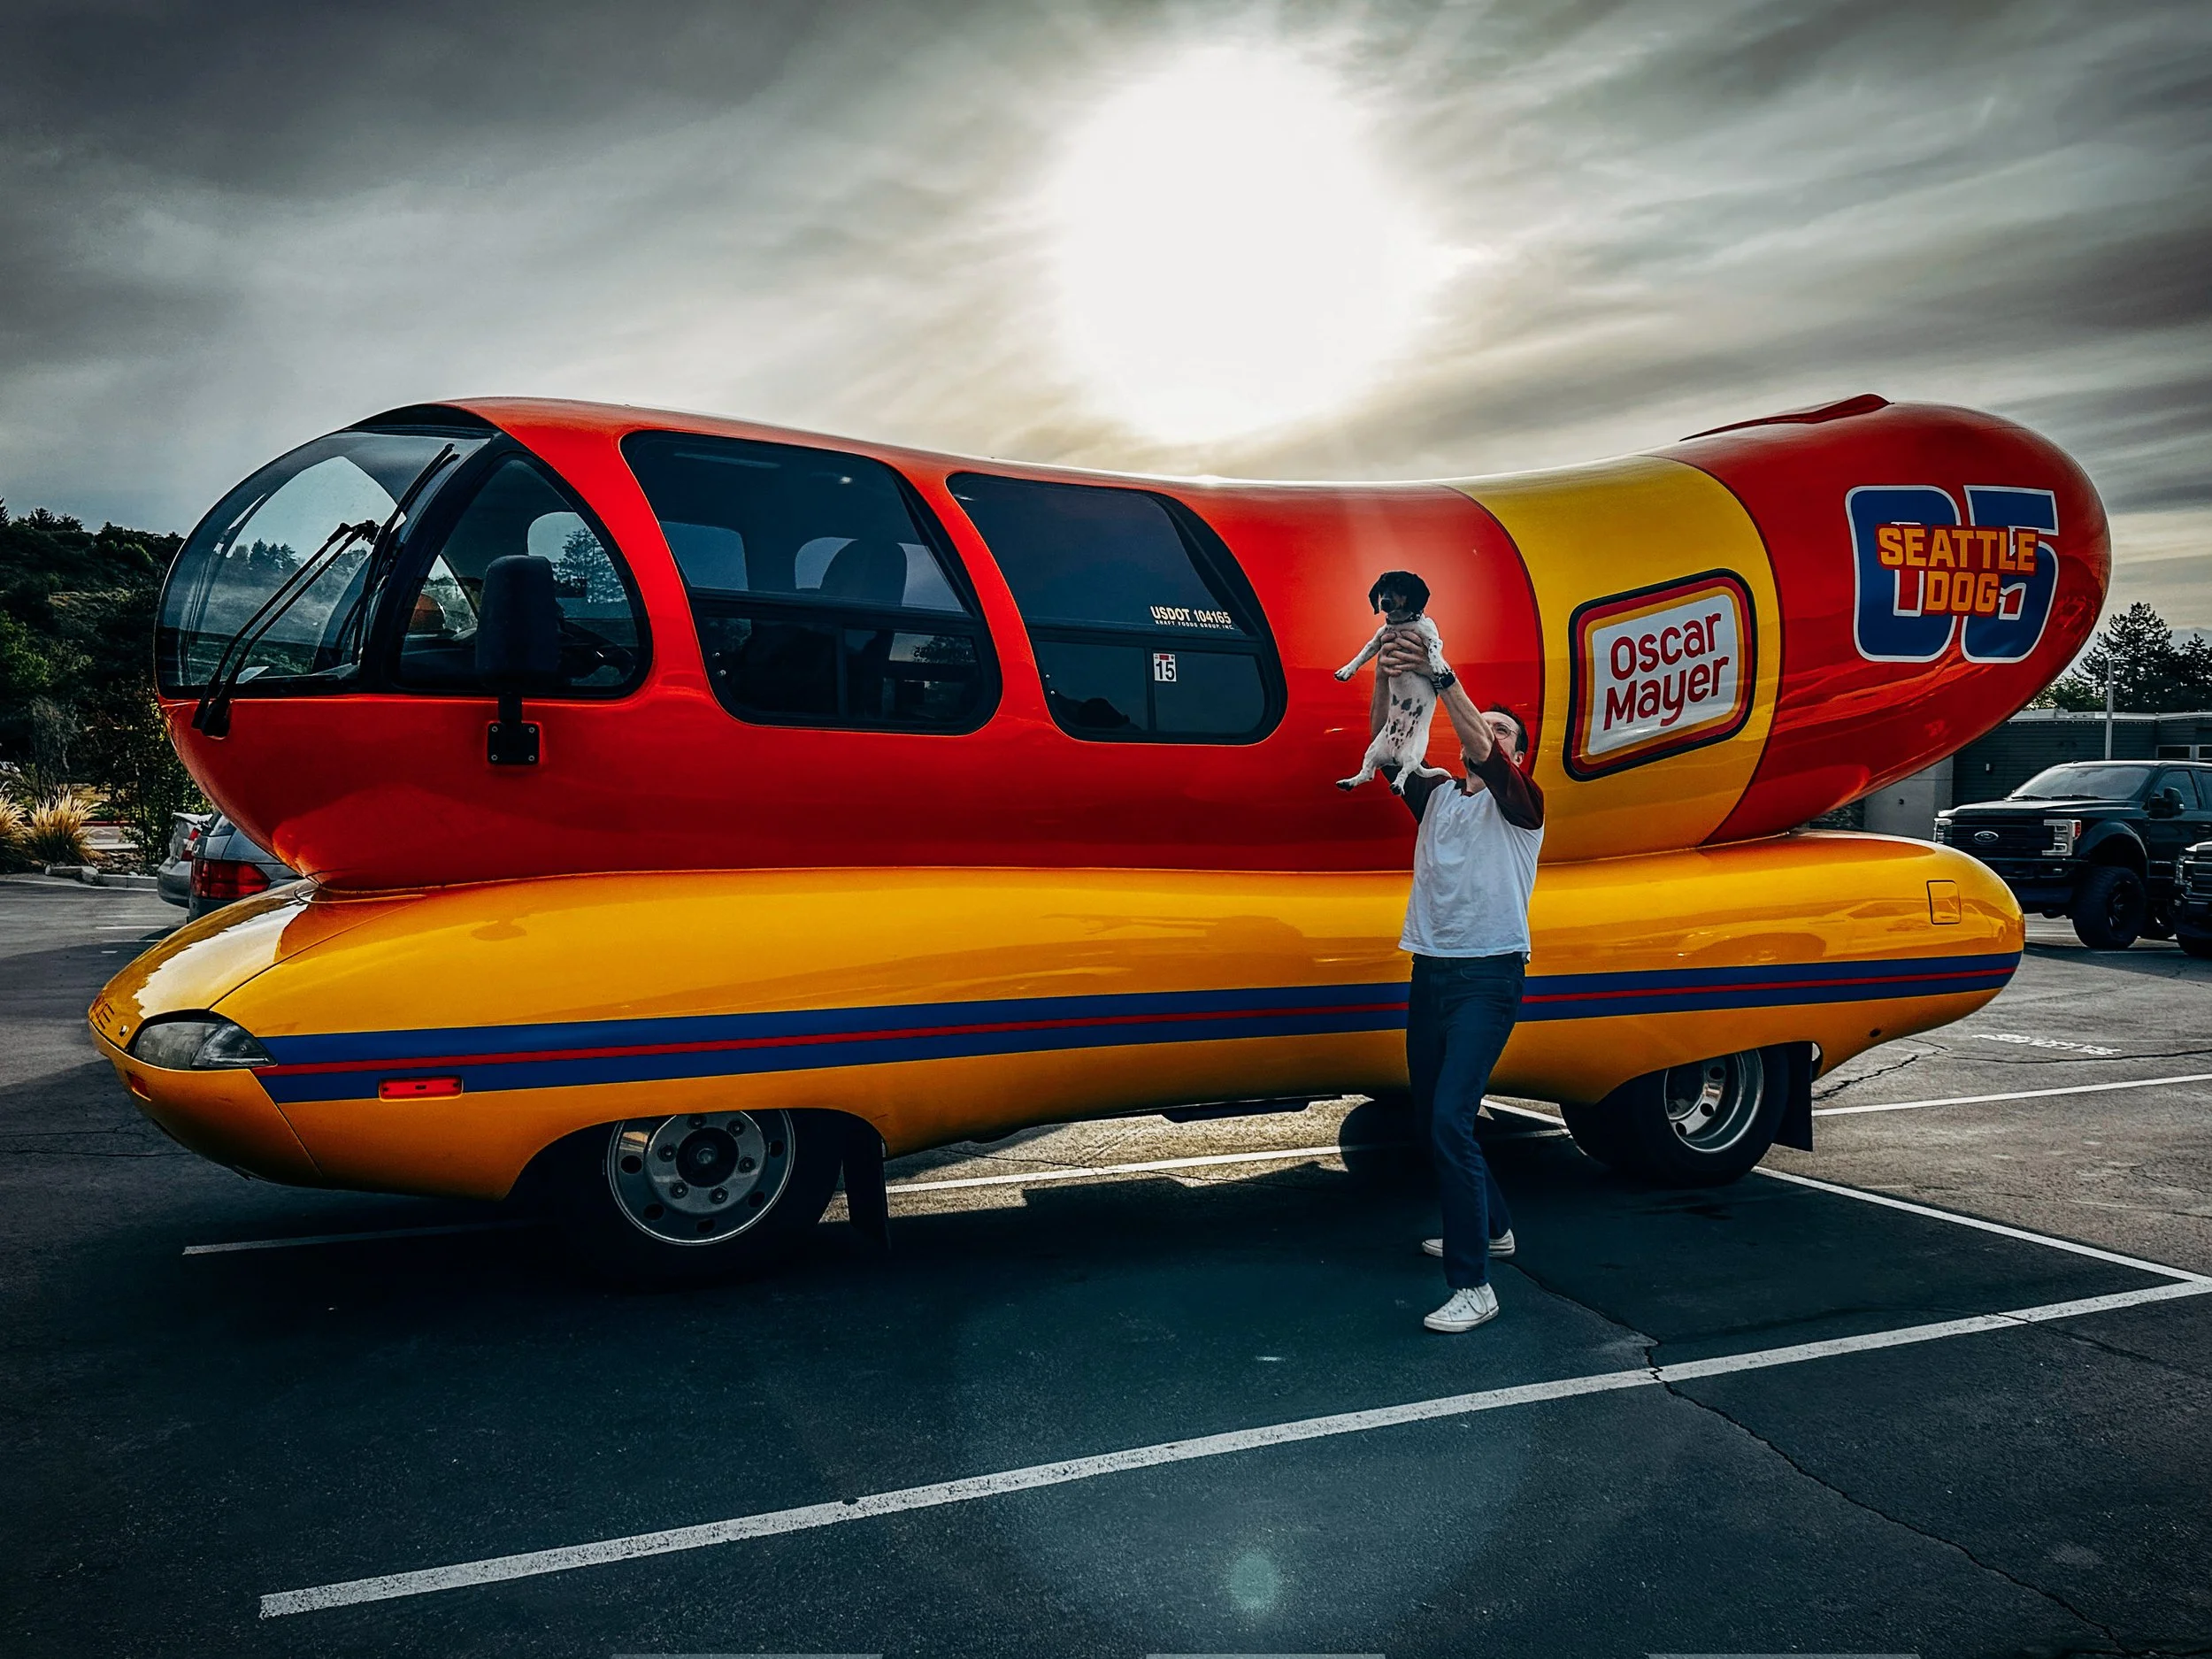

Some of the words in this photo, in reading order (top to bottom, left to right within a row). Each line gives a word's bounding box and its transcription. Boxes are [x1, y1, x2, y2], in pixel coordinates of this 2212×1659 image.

[1878, 527, 2036, 572] SEATTLE
[1925, 571, 2000, 612] DOG
[1150, 606, 1190, 621] USDOT
[1193, 609, 1232, 624] 104165
[1609, 612, 1722, 680] Oscar
[1156, 660, 1175, 680] 15
[1603, 656, 1730, 731] Mayer
